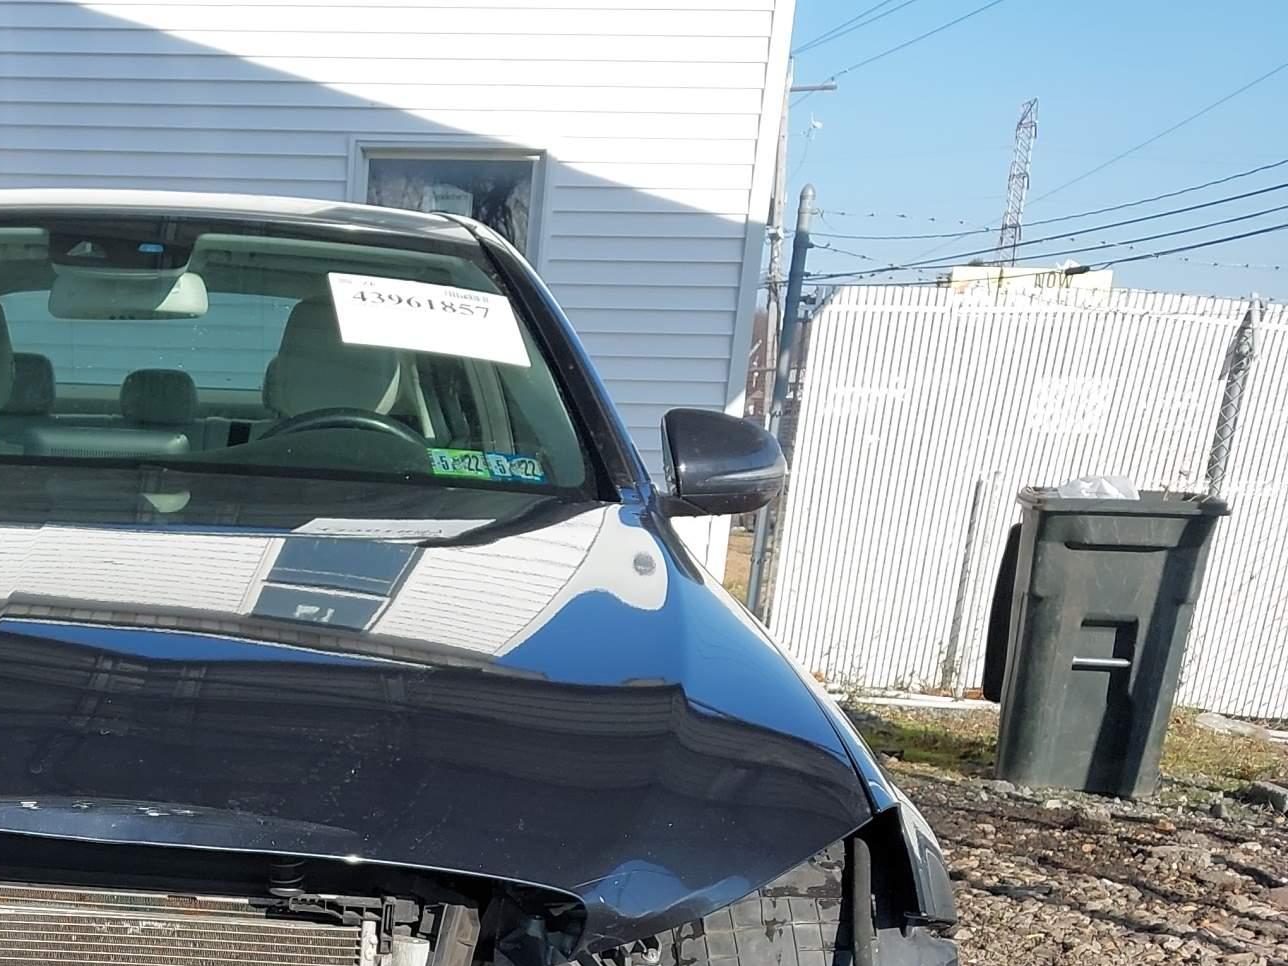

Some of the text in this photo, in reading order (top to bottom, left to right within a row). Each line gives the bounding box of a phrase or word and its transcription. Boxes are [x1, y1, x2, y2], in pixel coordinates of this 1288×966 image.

[352, 290, 489, 319] 43961857
[439, 454, 483, 472] 5 22
[520, 458, 537, 477] 22
